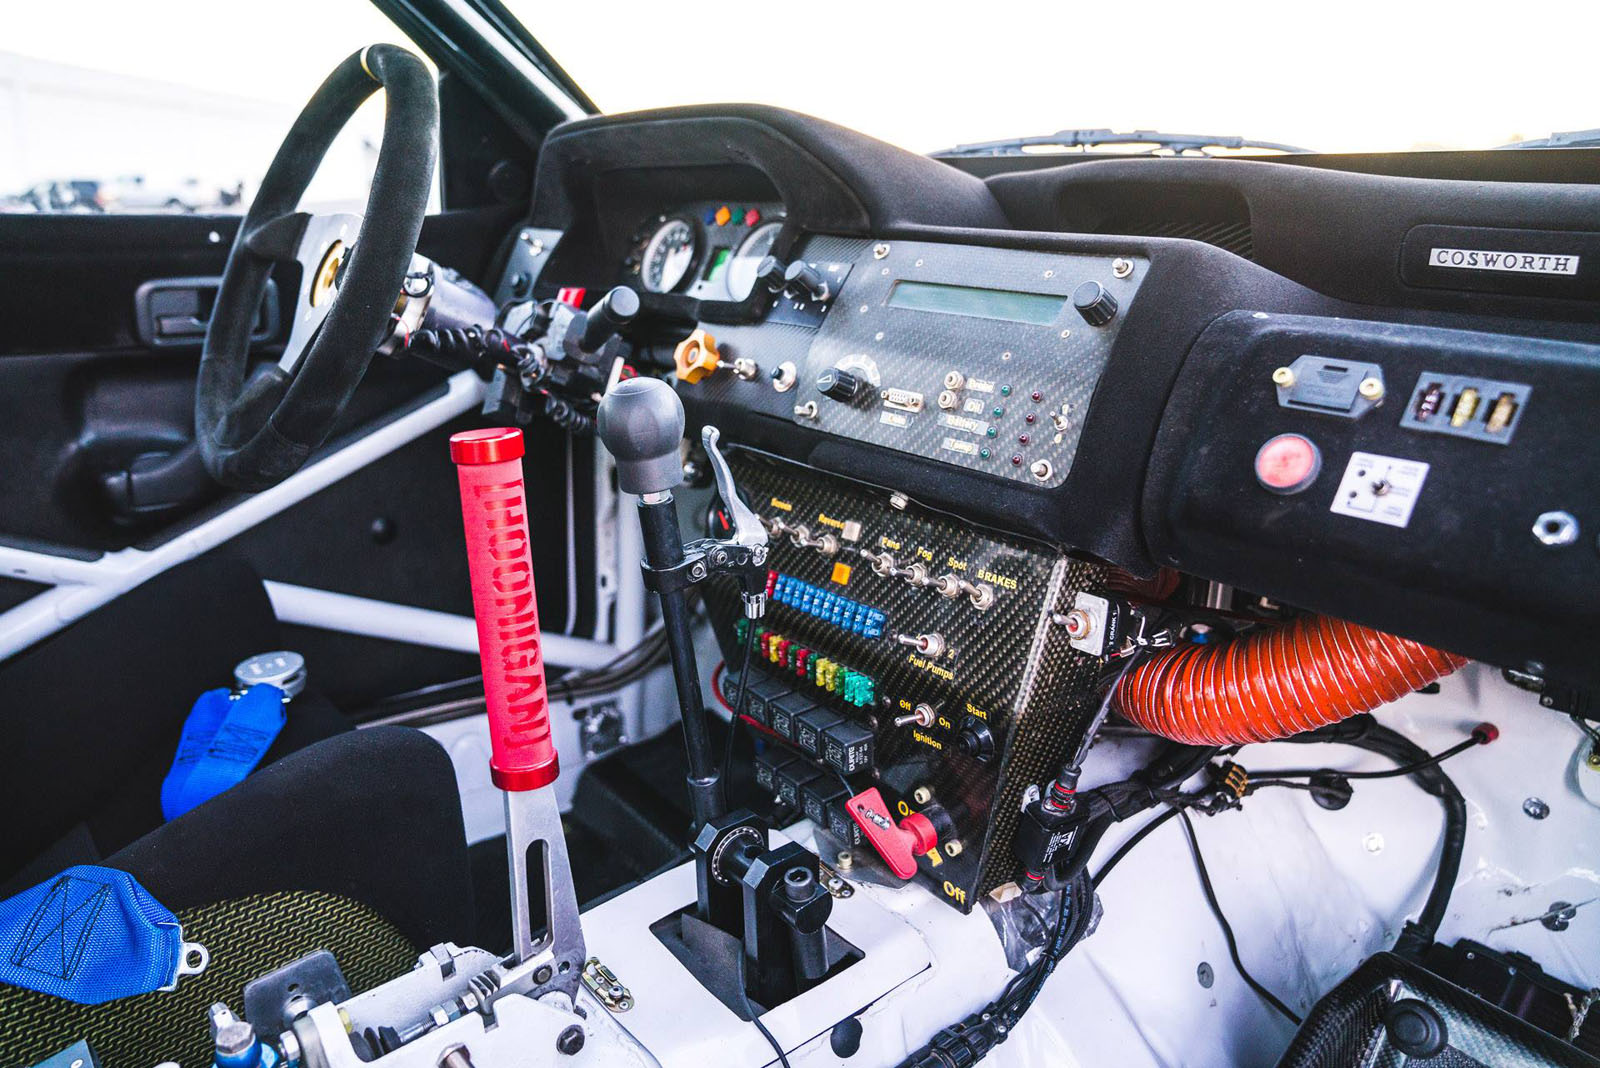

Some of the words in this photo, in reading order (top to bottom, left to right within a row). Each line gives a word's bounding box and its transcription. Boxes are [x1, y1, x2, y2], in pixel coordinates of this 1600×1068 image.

[1436, 250, 1570, 272] COSWORTH
[917, 546, 933, 561] Fog
[947, 557, 967, 571] Spot
[977, 569, 1017, 589] BRAKES
[947, 649, 955, 660] 2
[908, 653, 926, 669] Fuel
[926, 661, 954, 680] Pumps
[899, 699, 912, 711] Off
[966, 702, 988, 720] Start
[938, 716, 951, 729] On
[912, 729, 942, 750] Ignition
[943, 880, 966, 905] Off
